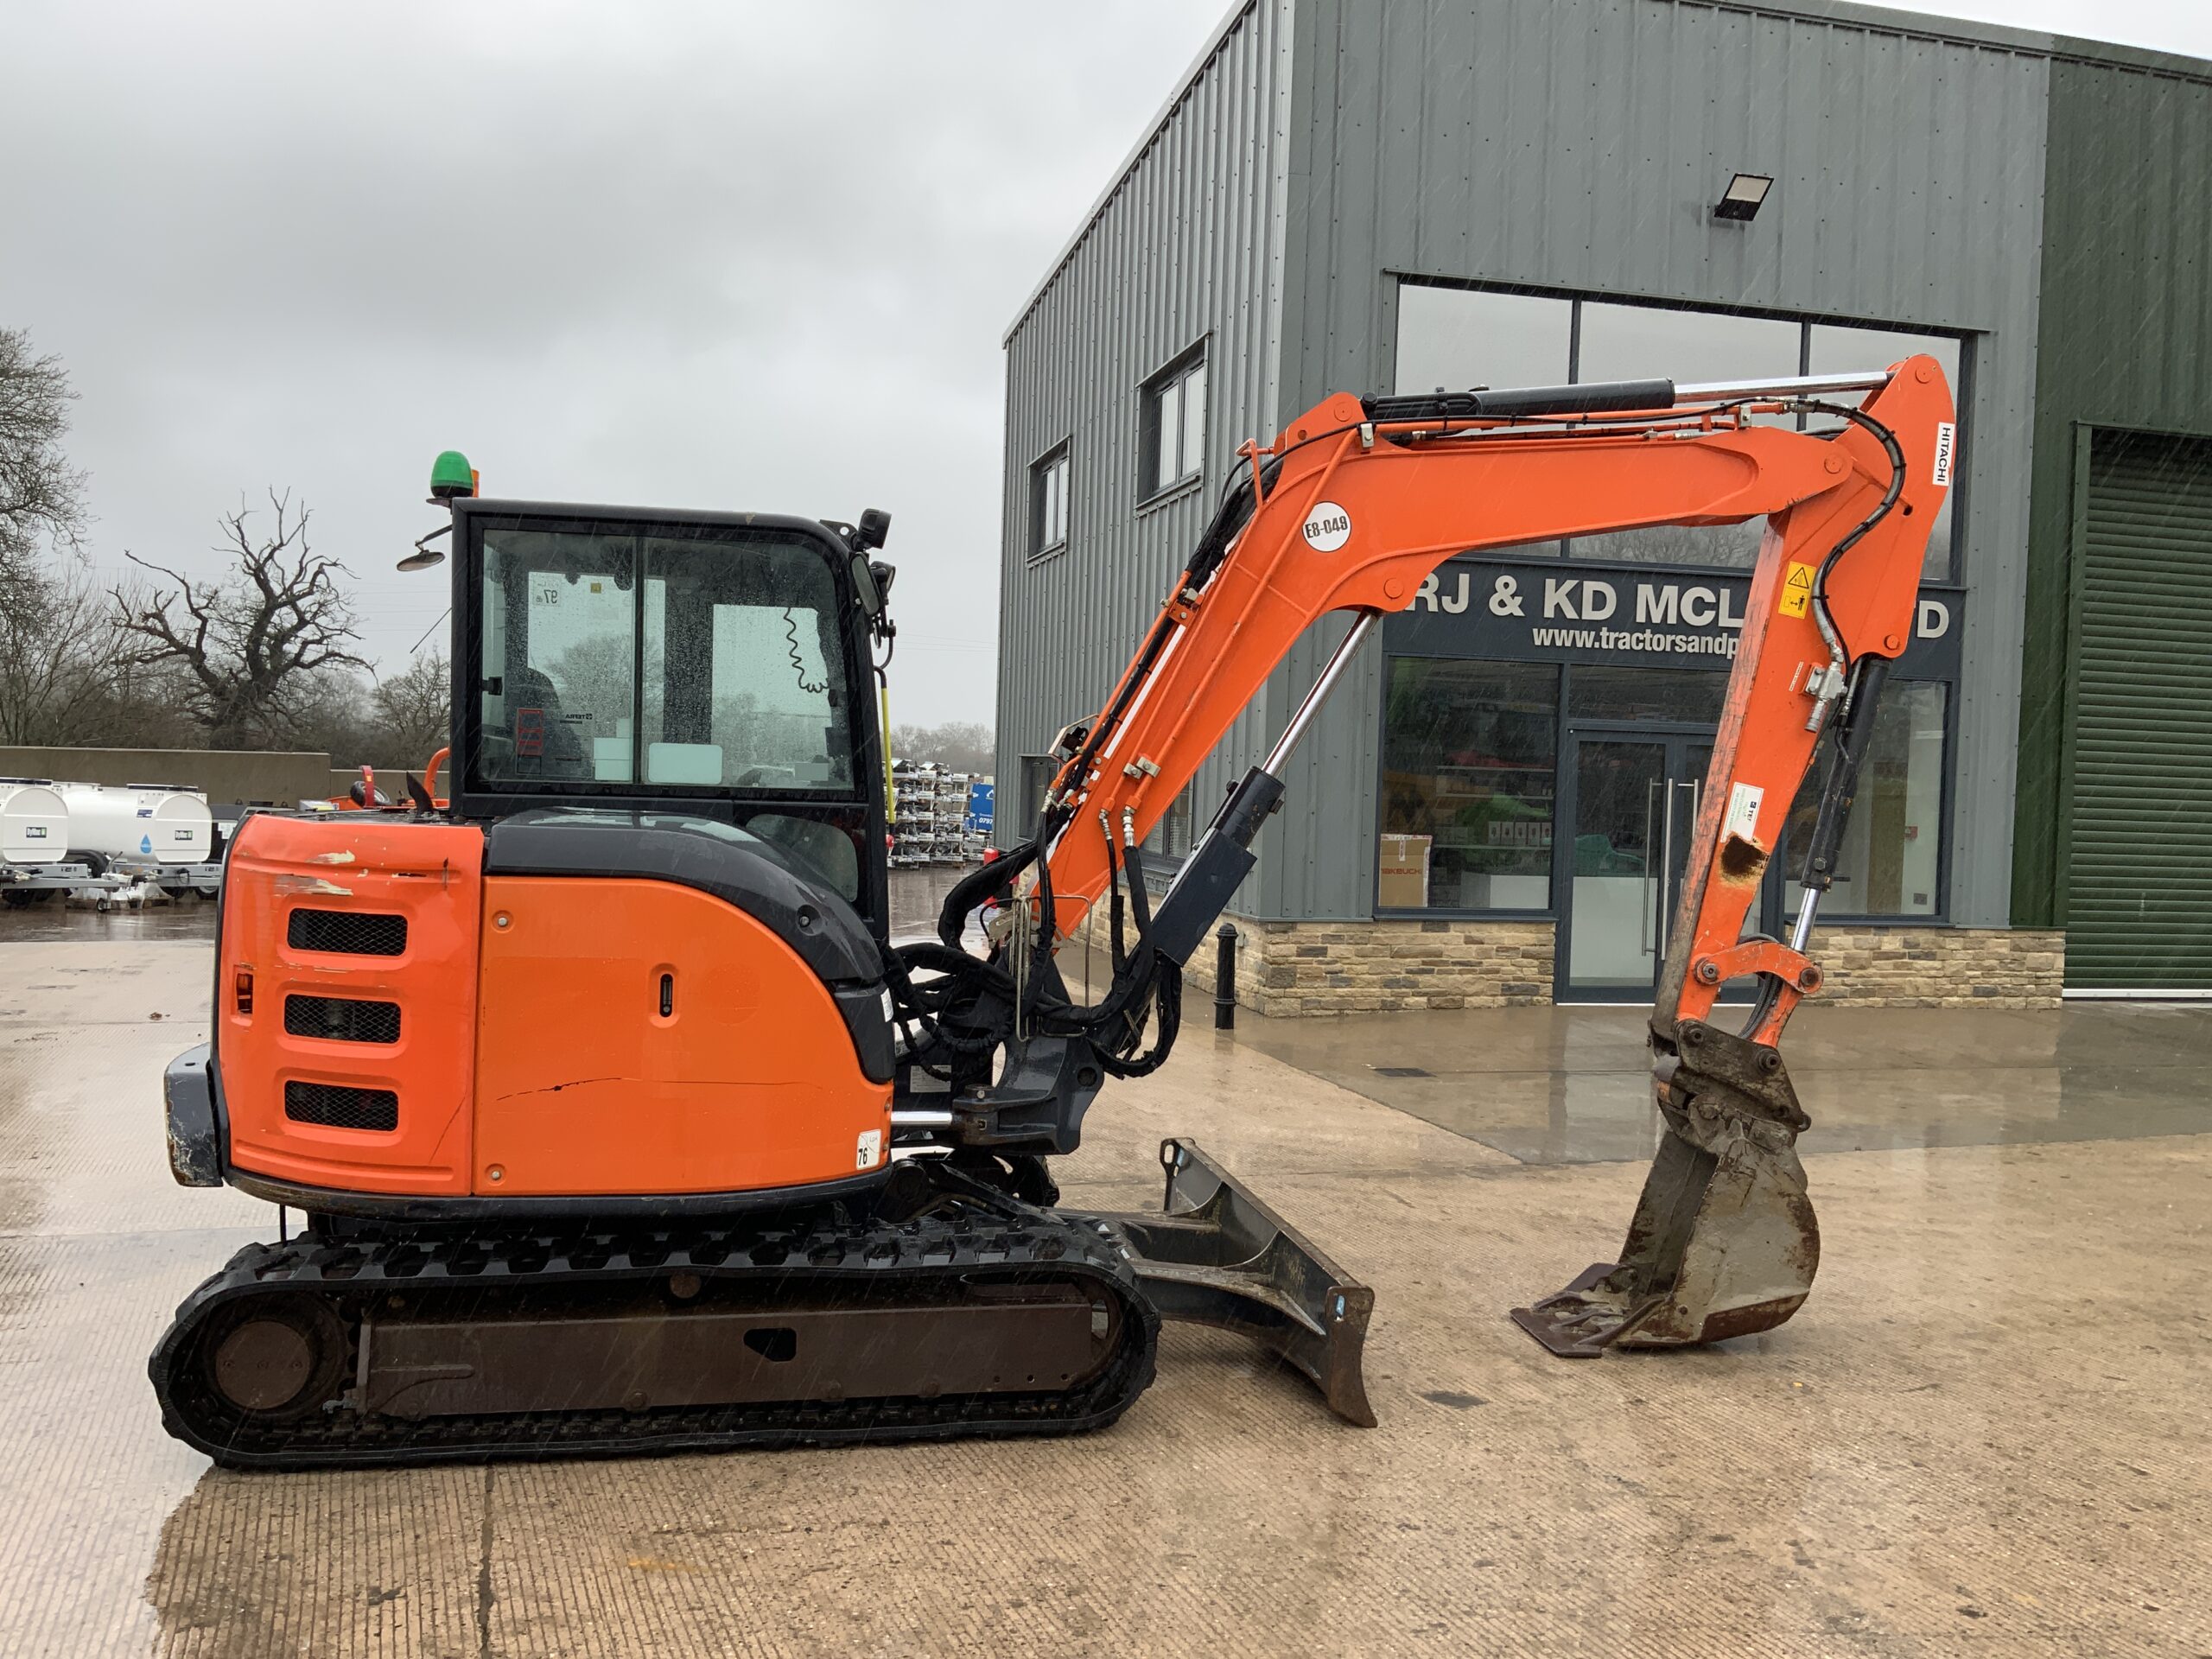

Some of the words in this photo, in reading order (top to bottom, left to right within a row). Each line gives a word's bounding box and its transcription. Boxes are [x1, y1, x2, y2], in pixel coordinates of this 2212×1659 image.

[1937, 427, 1951, 481] HITACHI
[1305, 515, 1348, 538] E8-049
[1404, 573, 1470, 613] RJ
[1489, 575, 1526, 617] &
[1543, 578, 1617, 620] KD
[858, 1147, 868, 1166] 76
